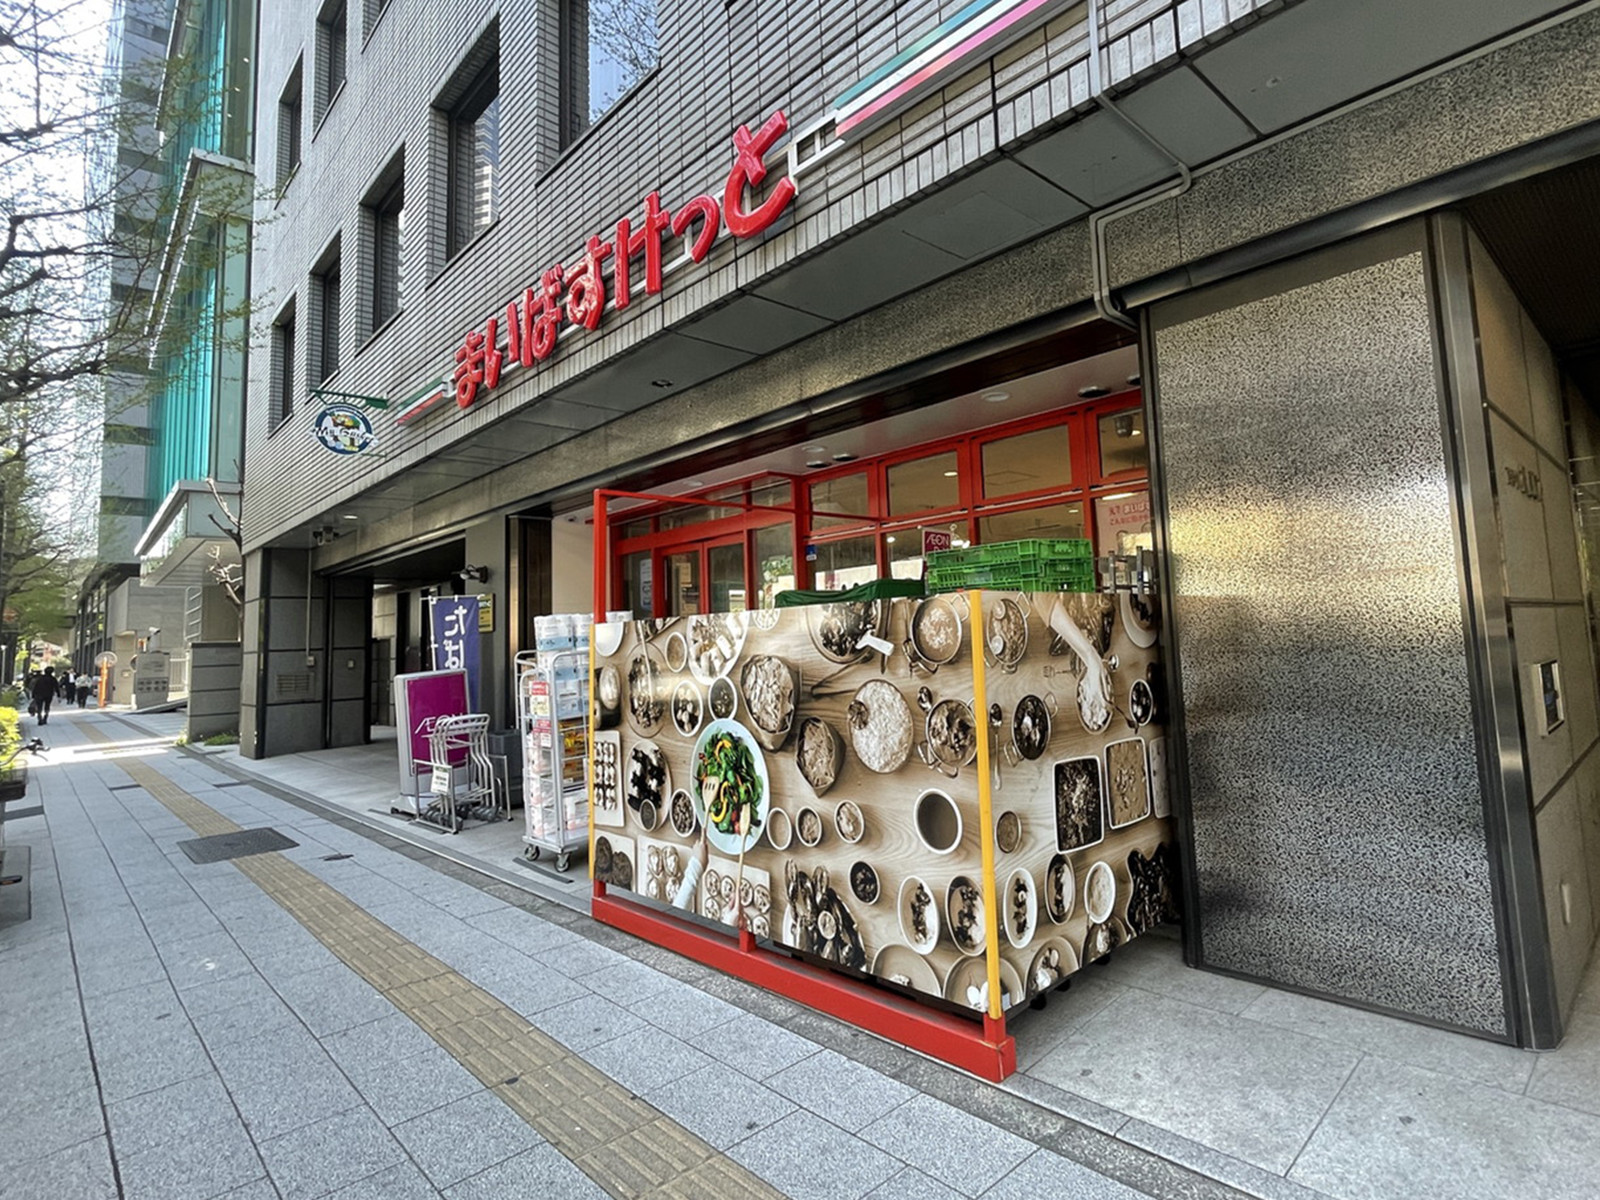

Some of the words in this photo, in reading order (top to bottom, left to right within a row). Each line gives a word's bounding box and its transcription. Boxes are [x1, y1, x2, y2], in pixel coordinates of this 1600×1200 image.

[454, 110, 797, 408] まいばすけっと
